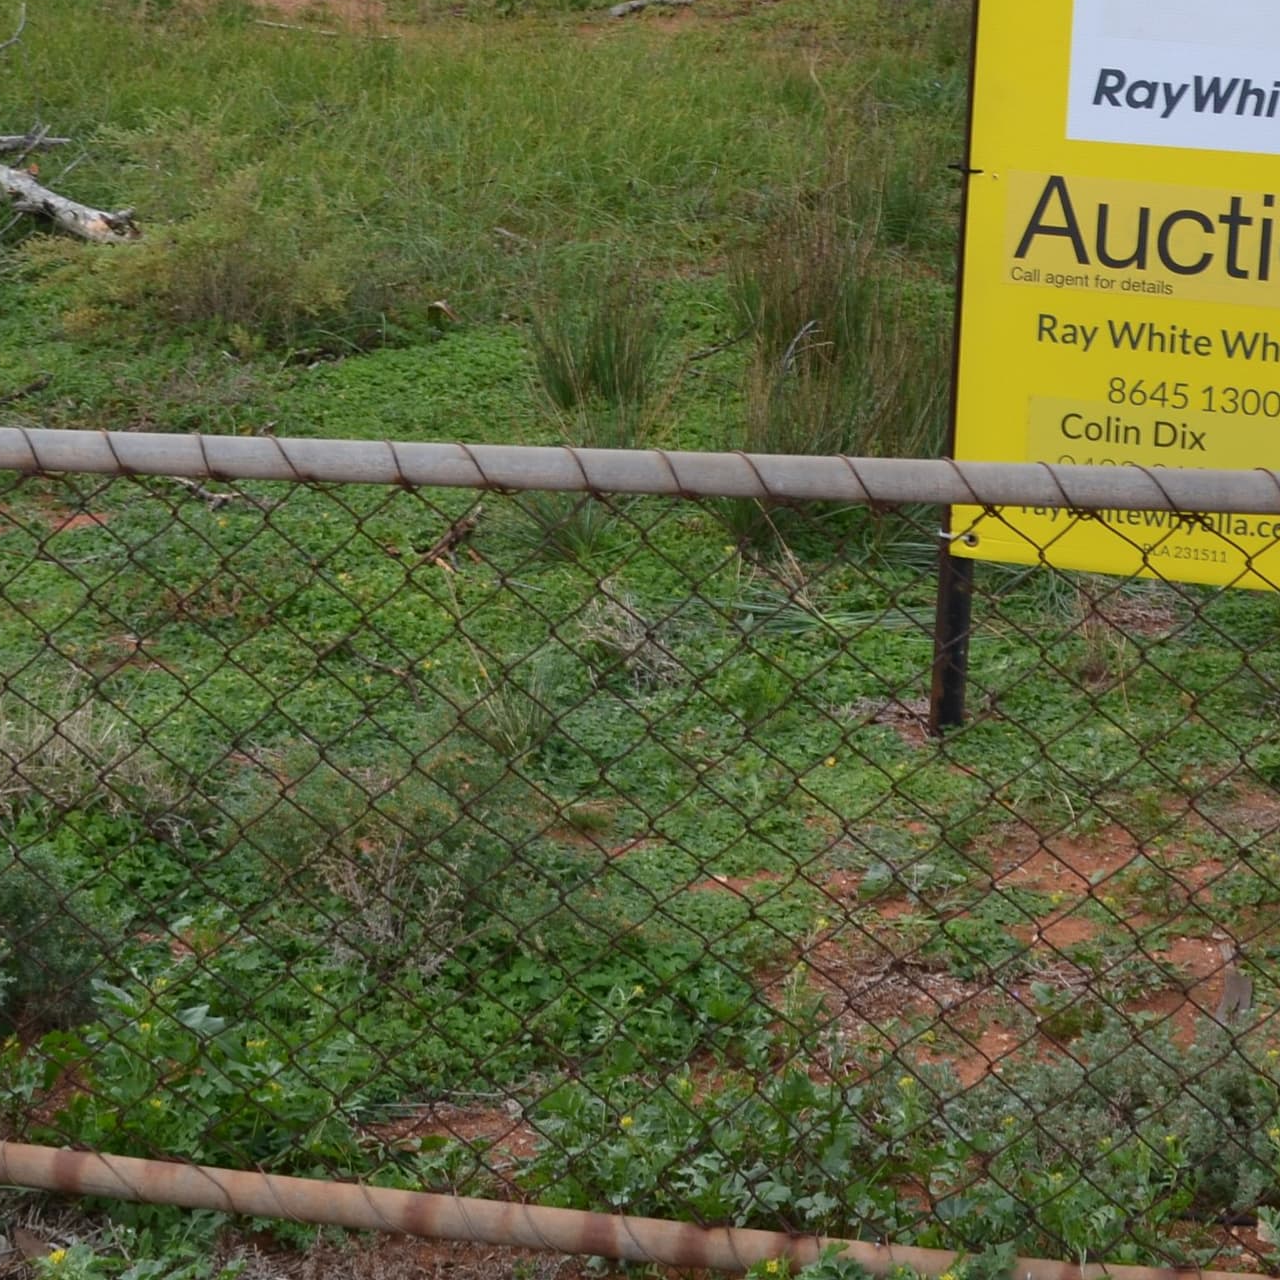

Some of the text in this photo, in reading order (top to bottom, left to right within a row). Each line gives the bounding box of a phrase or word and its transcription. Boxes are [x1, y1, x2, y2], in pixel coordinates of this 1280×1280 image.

[1010, 266, 1174, 296] Call agent for details
[1036, 313, 1099, 353] Ray
[1107, 319, 1213, 357] White
[1107, 376, 1190, 410] 8645
[1060, 412, 1208, 452] Colin Dix
[1173, 546, 1228, 564] 231511
